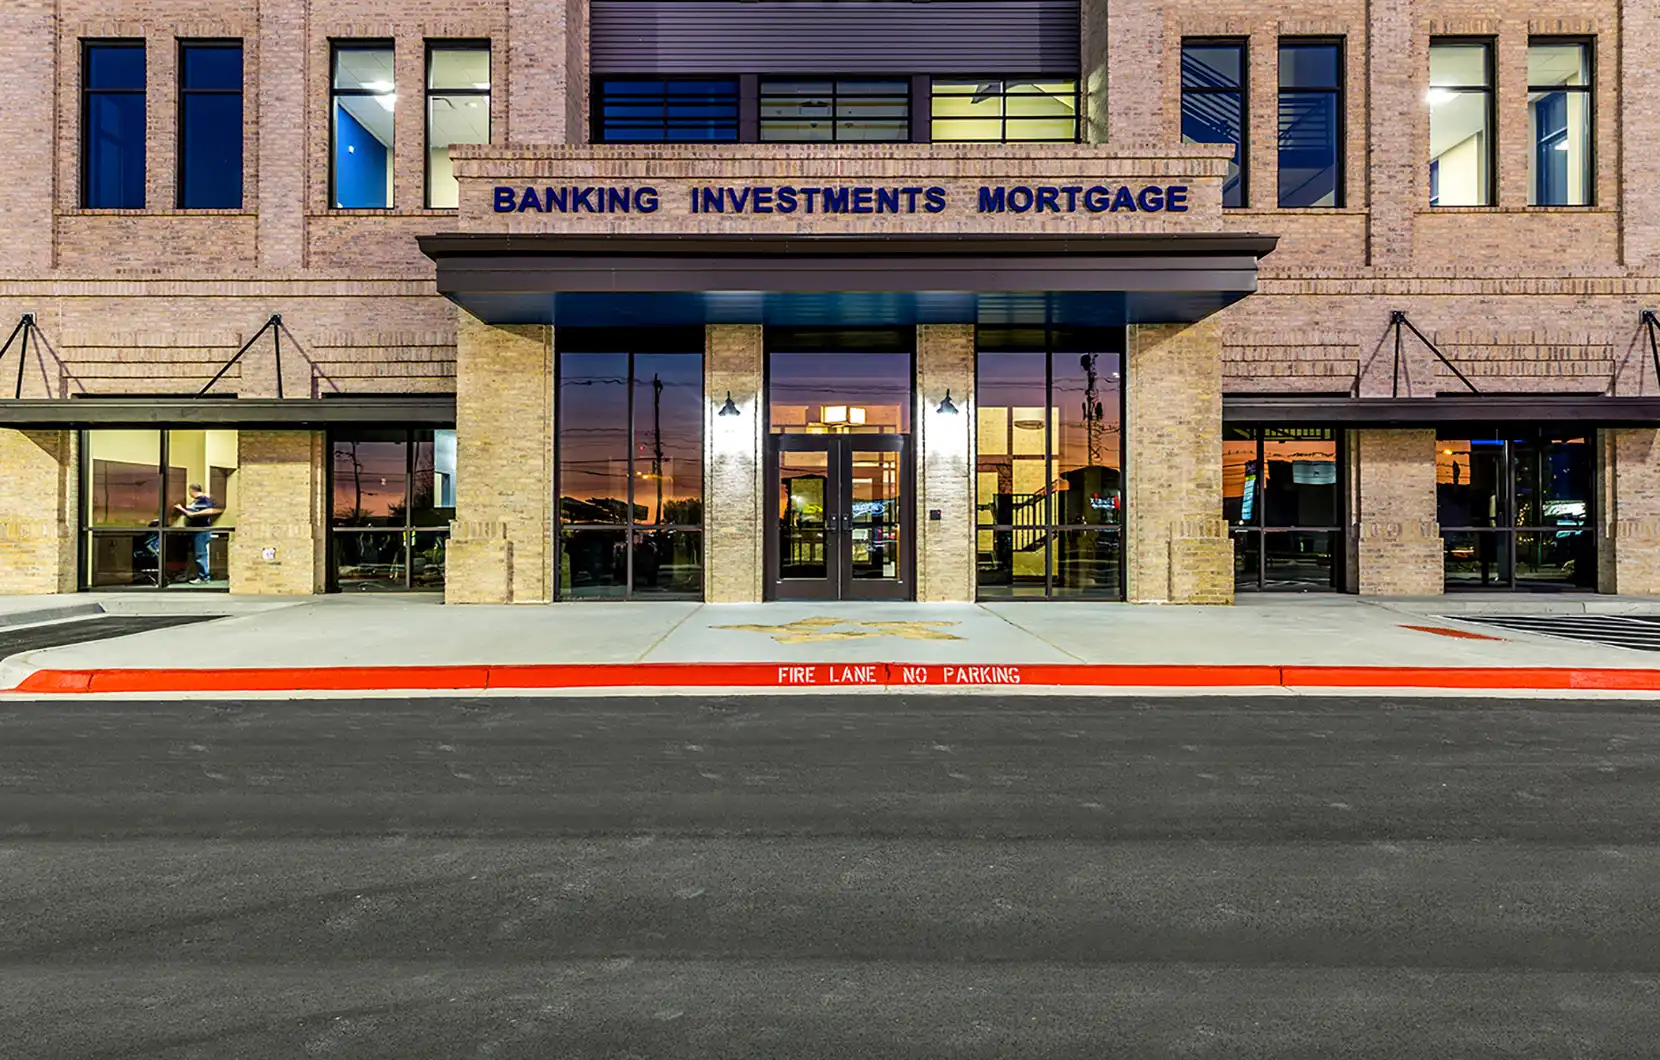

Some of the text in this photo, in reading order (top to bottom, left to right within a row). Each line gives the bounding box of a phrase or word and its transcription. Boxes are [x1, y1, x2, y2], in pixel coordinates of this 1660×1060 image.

[494, 186, 1188, 211] BANKING INVESTMENTS MORTGAGE
[778, 666, 1021, 683] FIRE LANE NO PARKING
